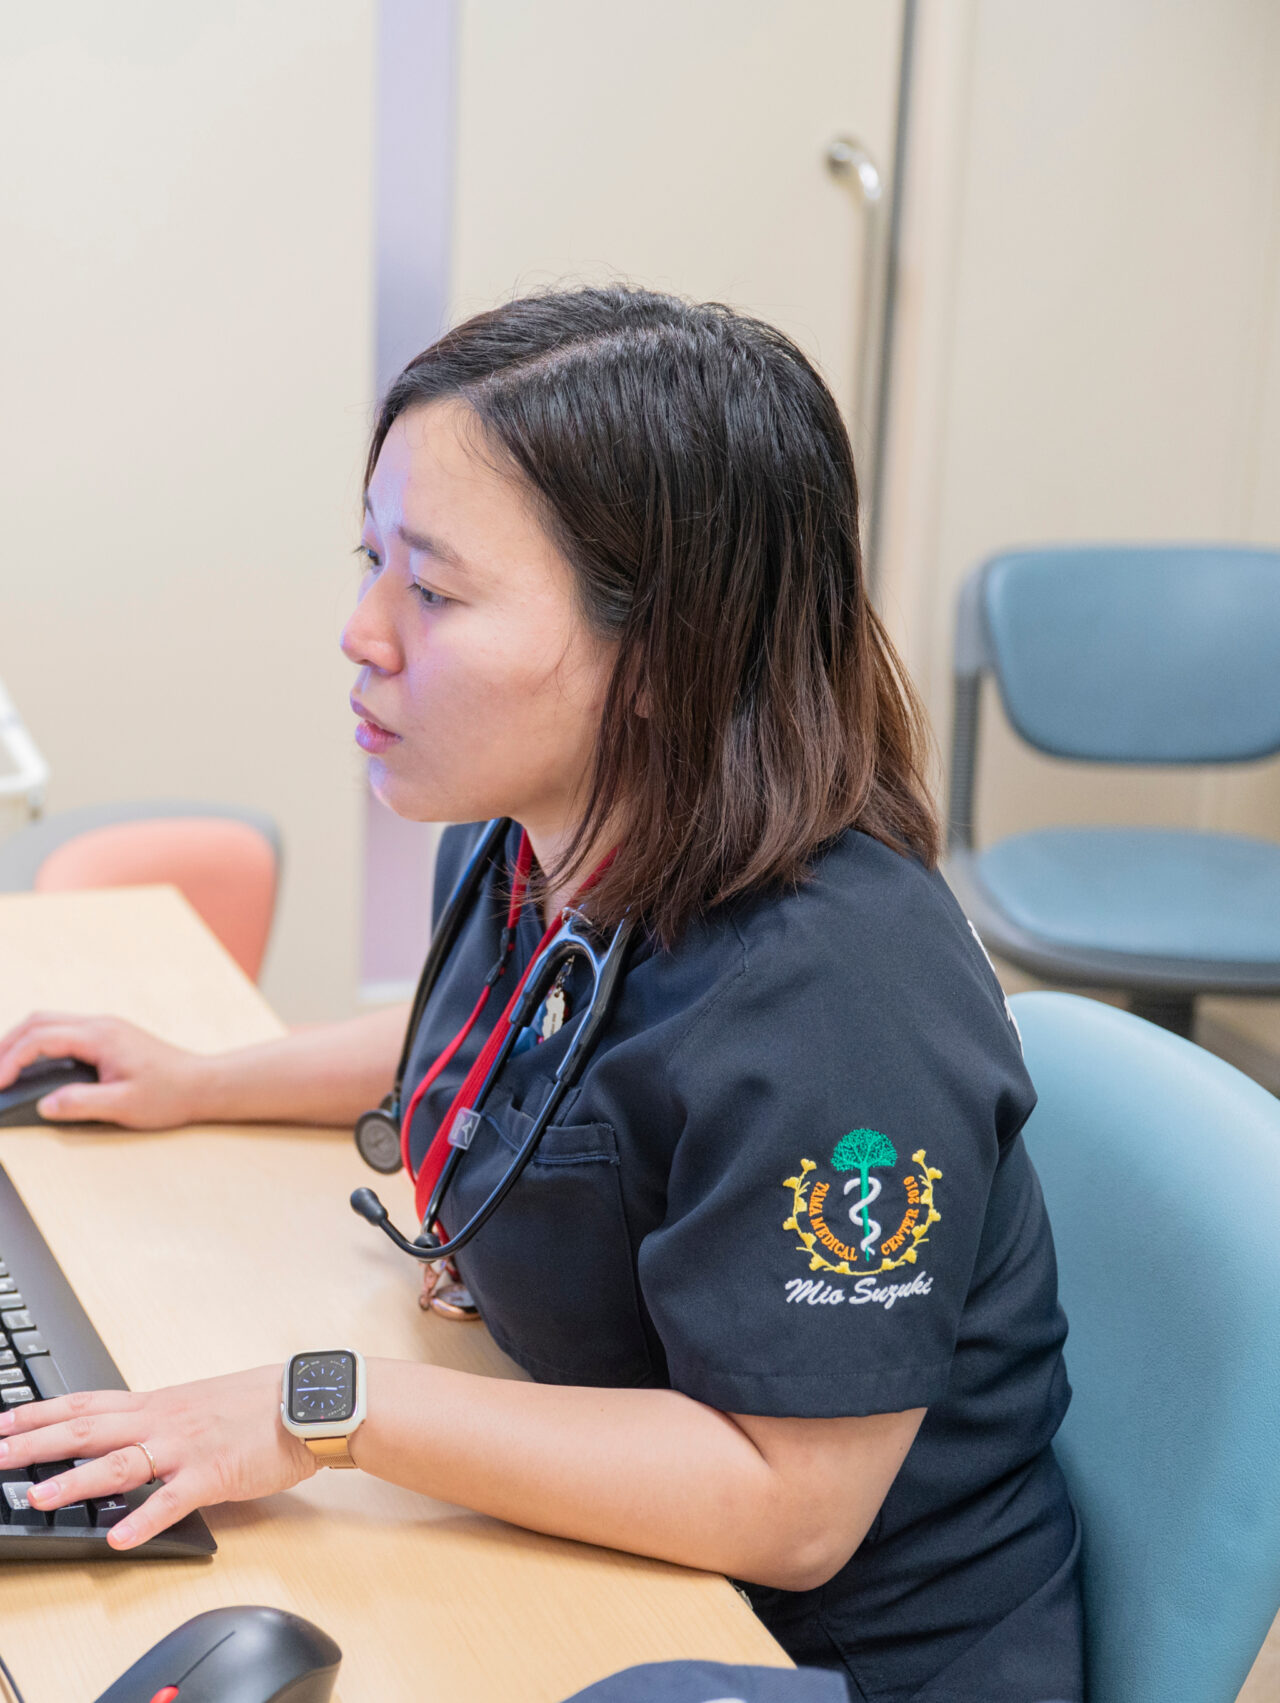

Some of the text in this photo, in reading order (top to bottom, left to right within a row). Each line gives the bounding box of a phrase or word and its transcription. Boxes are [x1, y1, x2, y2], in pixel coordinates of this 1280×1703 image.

[811, 1217, 858, 1261] MEDICAL
[881, 1208, 920, 1255] CENTER
[903, 1176, 920, 1205] 2010
[785, 1270, 934, 1310] Mio Suzuki
